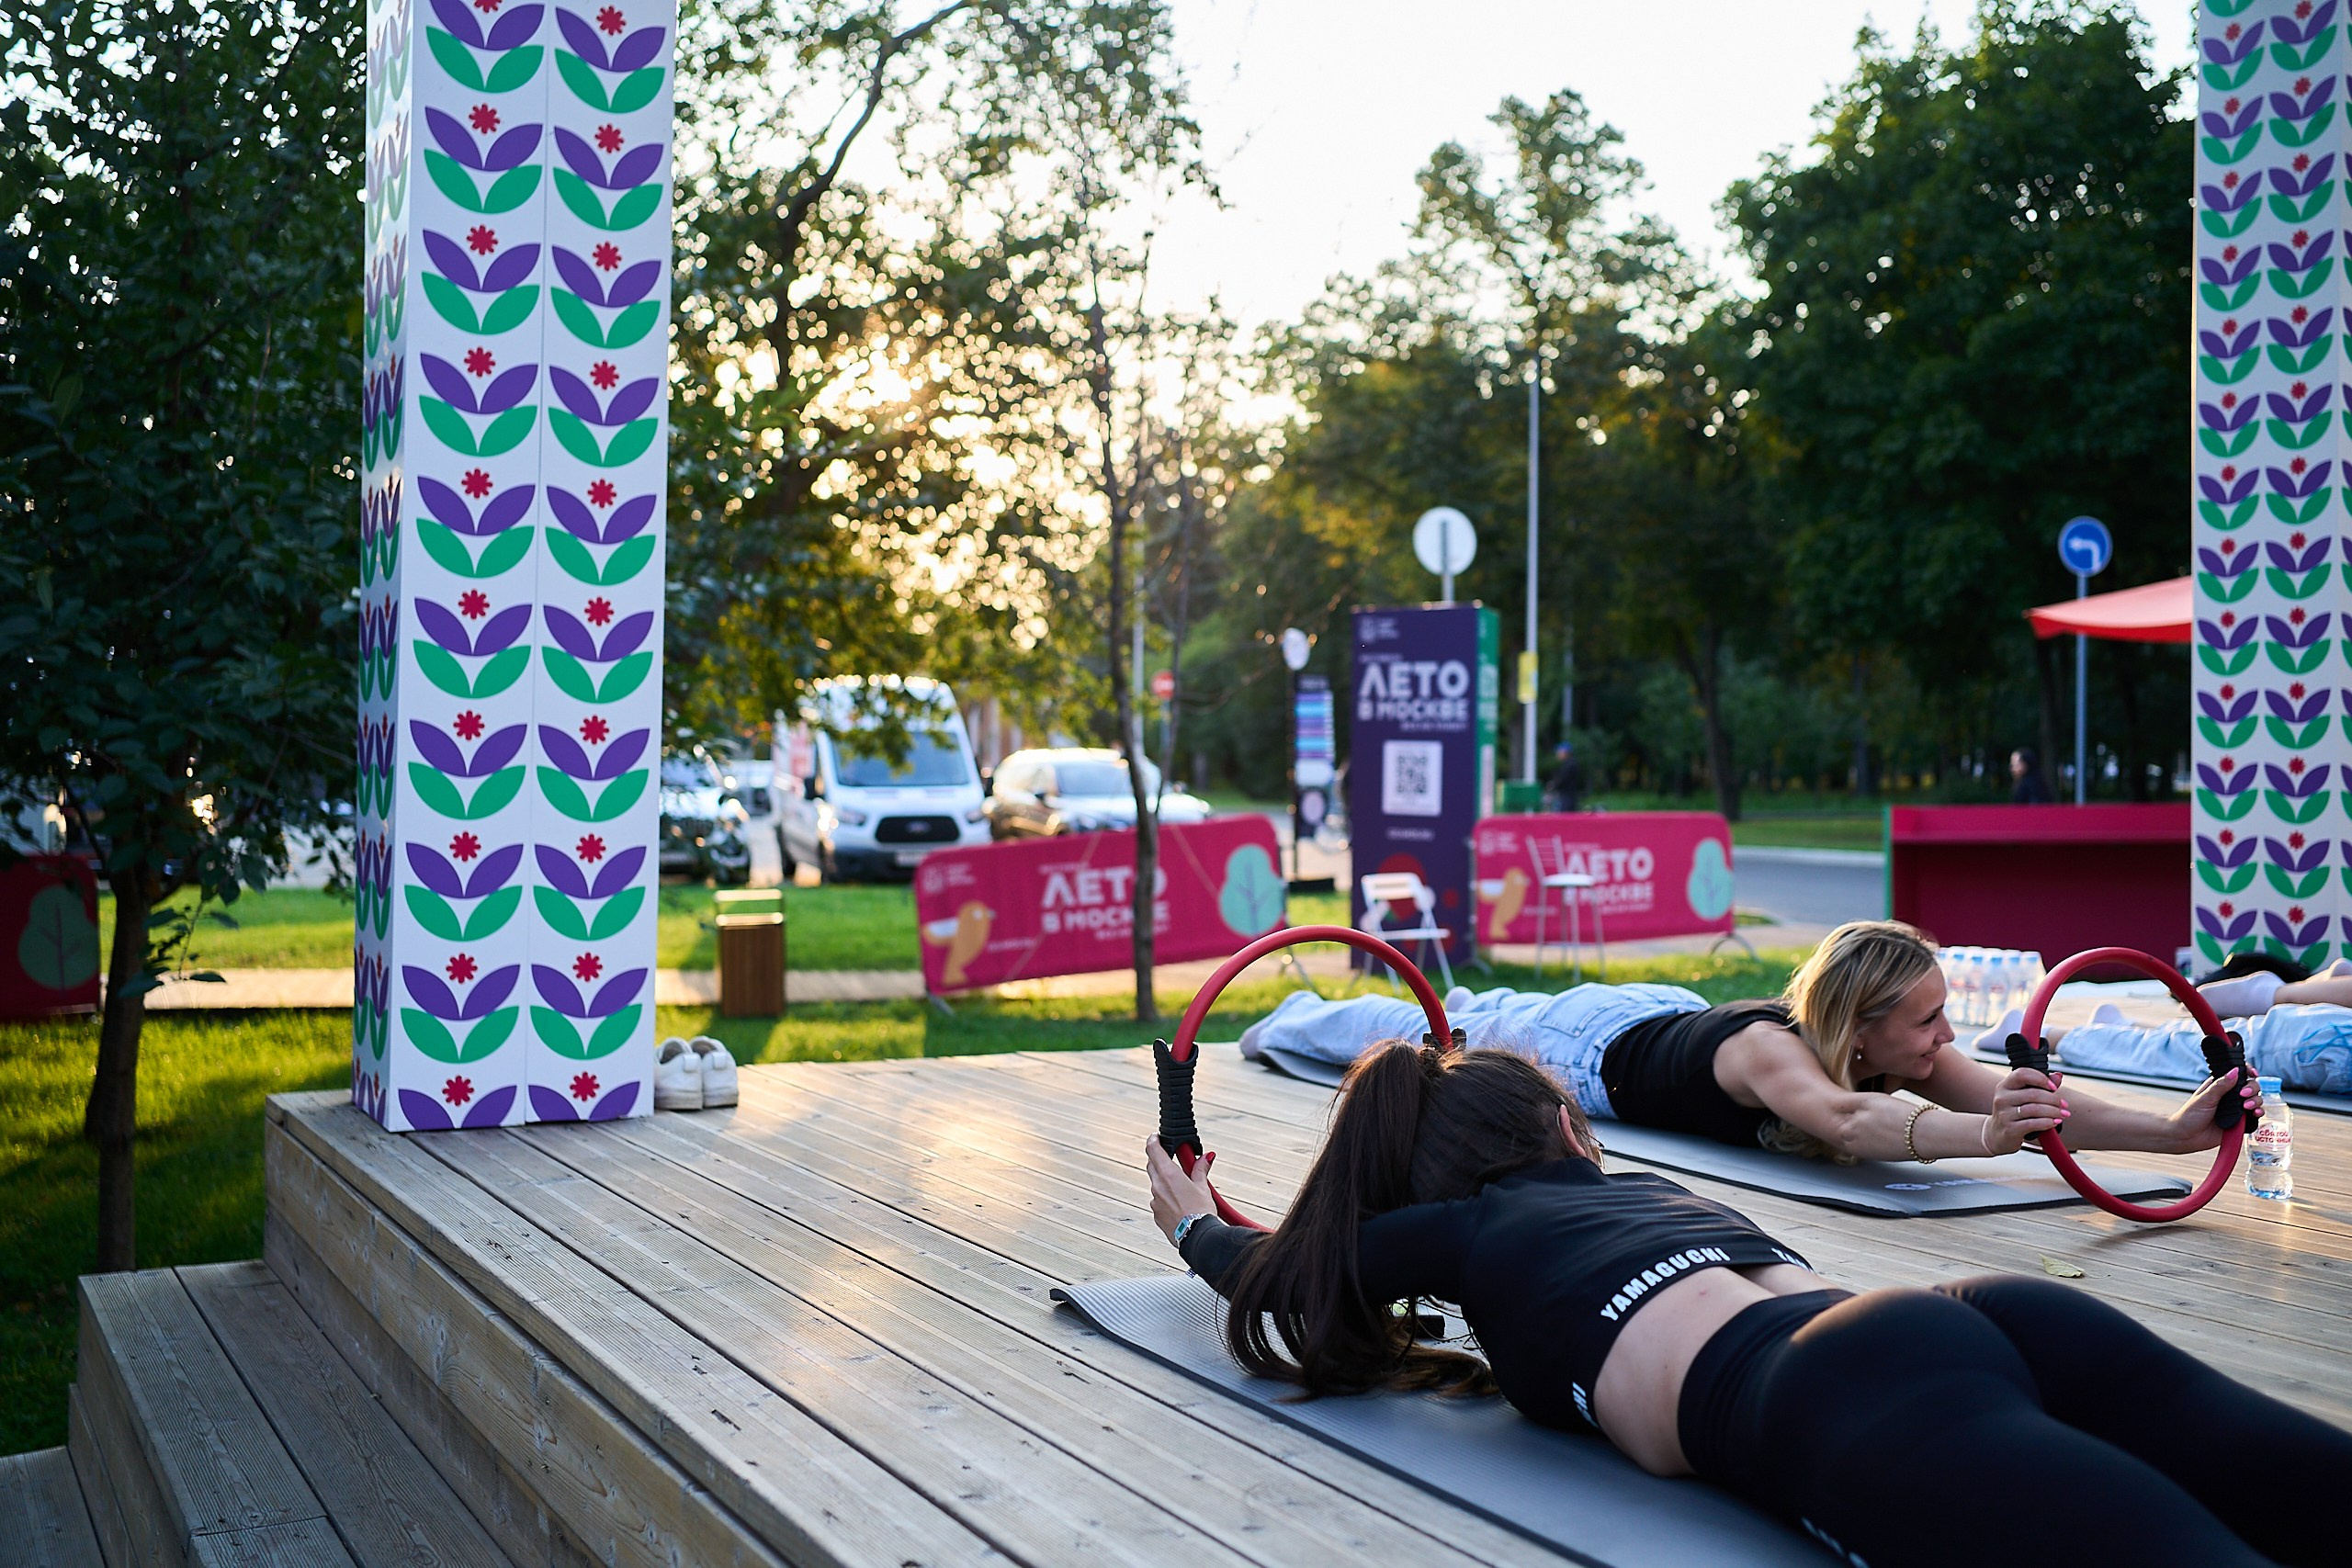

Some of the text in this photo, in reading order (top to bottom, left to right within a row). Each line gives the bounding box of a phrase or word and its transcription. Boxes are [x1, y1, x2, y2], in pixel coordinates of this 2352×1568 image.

[1359, 660, 1470, 699] ЛЕТО
[1376, 699, 1469, 721] МОСКВЕ
[1042, 912, 1060, 933] В
[1600, 1247, 1731, 1322] YAMAGUCHI
